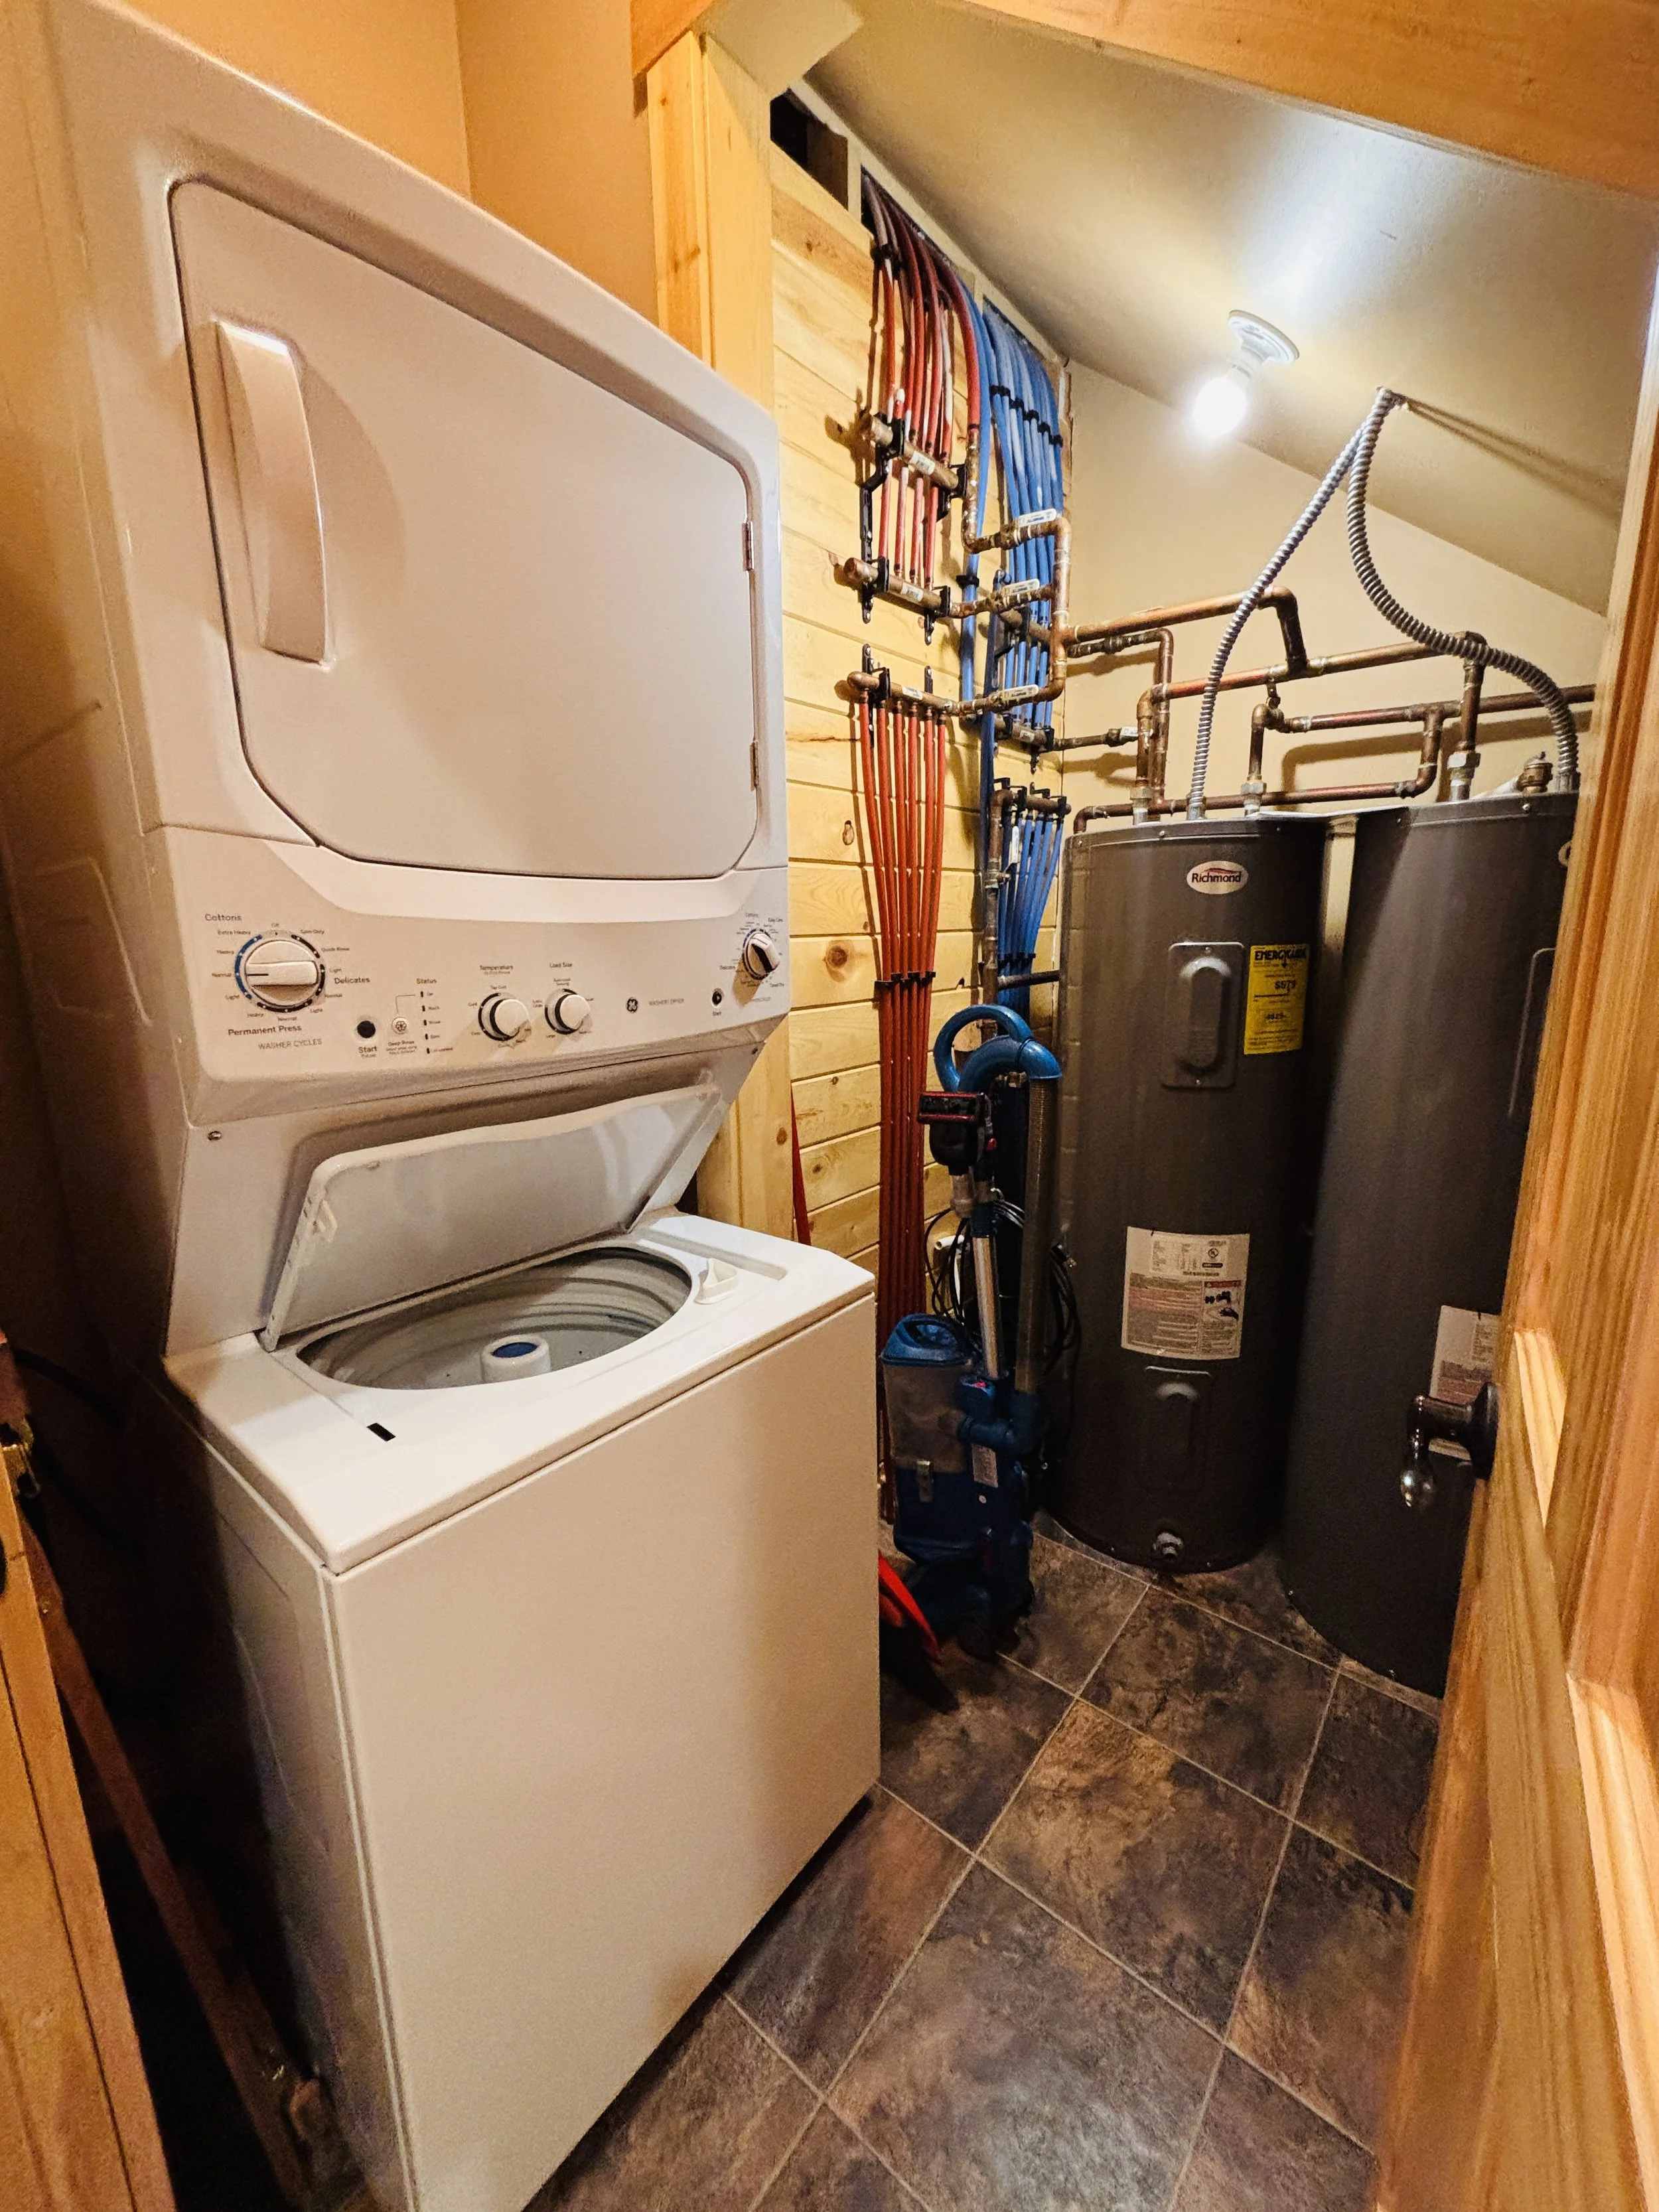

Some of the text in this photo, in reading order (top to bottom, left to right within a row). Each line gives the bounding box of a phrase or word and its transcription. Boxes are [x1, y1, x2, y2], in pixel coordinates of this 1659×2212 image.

[1191, 871, 1242, 883] Richmond
[228, 1027, 277, 1036] Permanent
[257, 1041, 292, 1050] WASHER
[358, 1045, 378, 1054] Start
